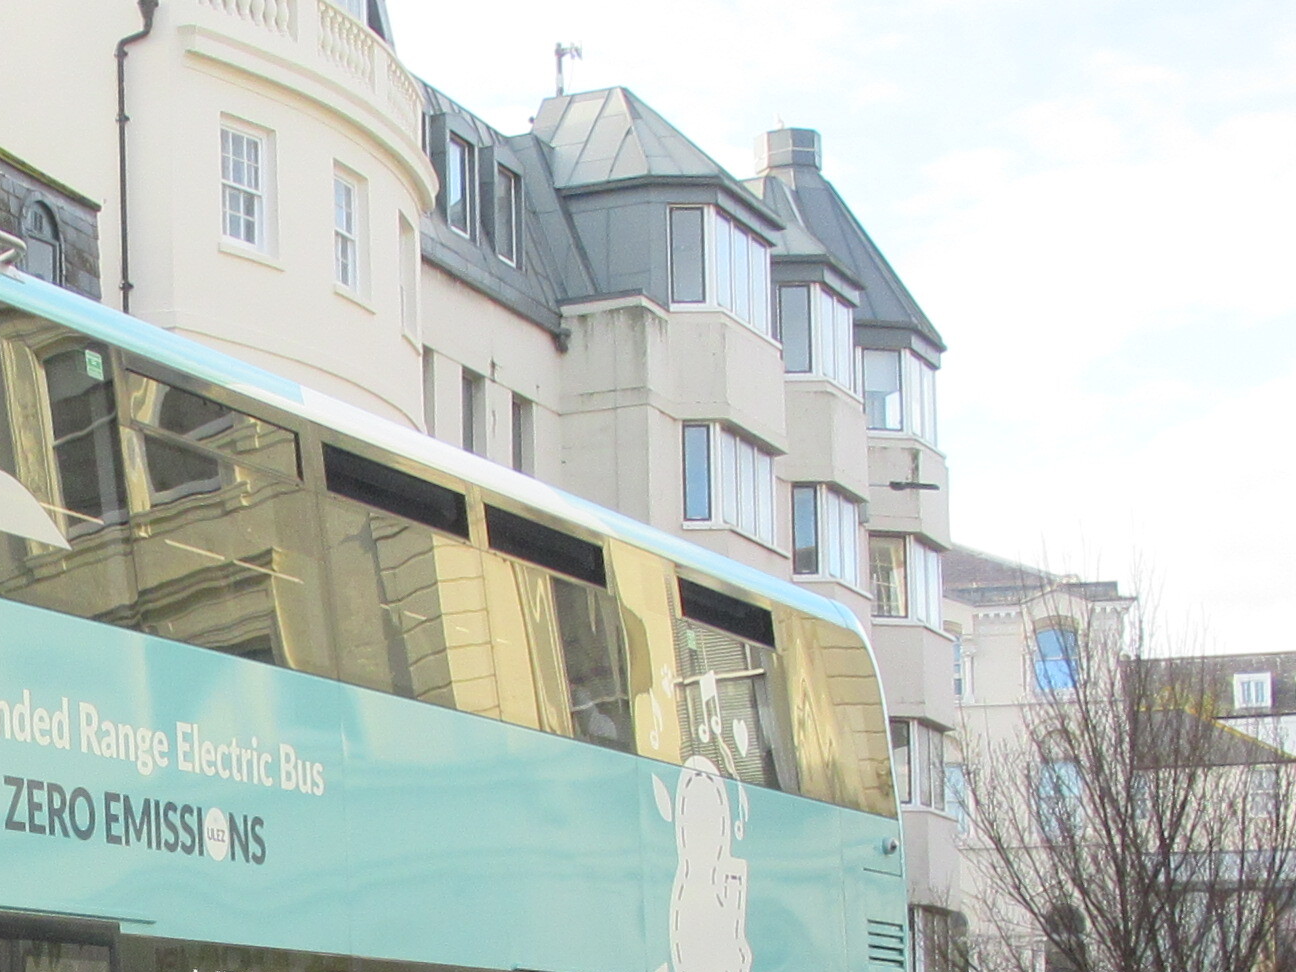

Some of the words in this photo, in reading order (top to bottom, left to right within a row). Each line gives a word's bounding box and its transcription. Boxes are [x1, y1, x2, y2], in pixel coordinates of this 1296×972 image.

[78, 701, 169, 776] Range
[175, 721, 273, 788] Electric
[279, 743, 325, 796] Bus
[4, 774, 96, 842] ZERO
[104, 791, 267, 866] EMISSIONS
